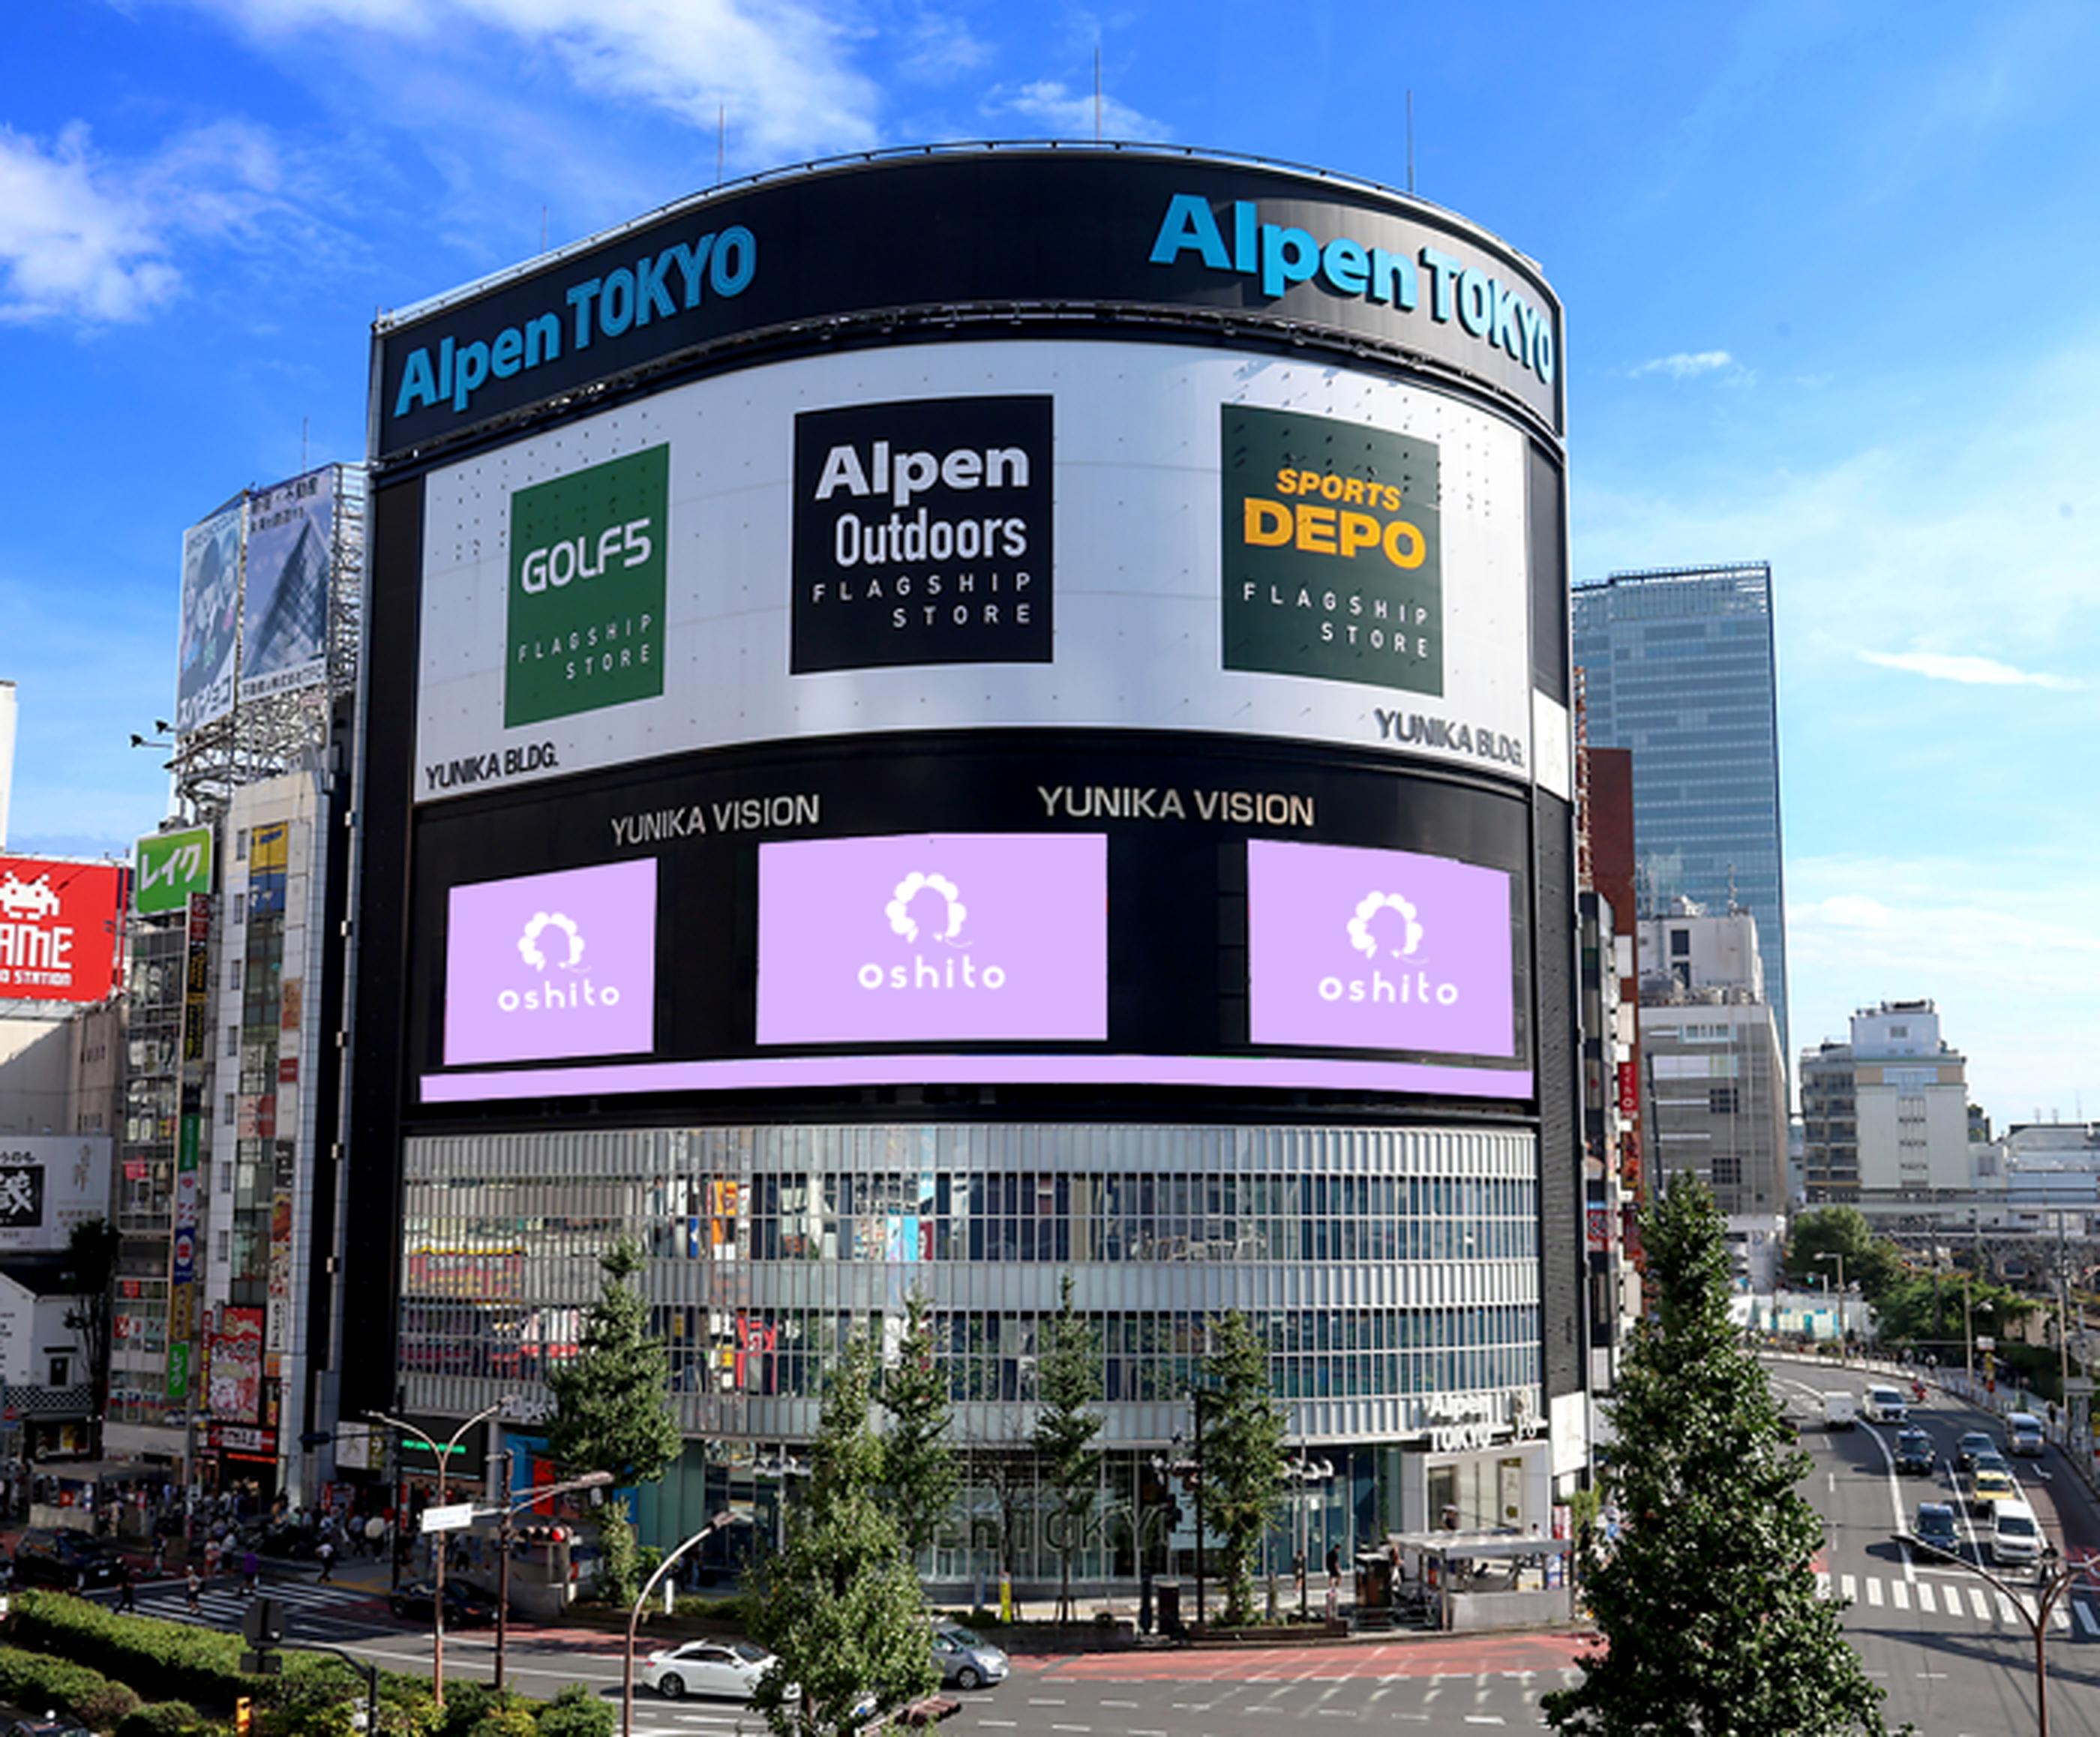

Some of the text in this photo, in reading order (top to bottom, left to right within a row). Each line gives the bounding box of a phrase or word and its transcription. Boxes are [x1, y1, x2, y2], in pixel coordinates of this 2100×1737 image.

[1149, 193, 1554, 386] Alpen TOKYO
[394, 224, 758, 418] Alpen TOKYO
[814, 440, 1030, 508] Alpen
[1276, 467, 1402, 512] SPORTS
[521, 517, 652, 595] GOLF5
[835, 506, 1028, 567] Outdoors
[1244, 496, 1427, 570] DEPO
[812, 571, 1031, 604] FLAGSHIP
[1243, 581, 1428, 626] FLAGSHIP
[518, 614, 652, 664] FLAGSHIP
[892, 603, 1030, 628] STORE
[1320, 621, 1428, 658] STORE
[566, 644, 650, 680] STORE
[1374, 707, 1525, 767] YUNIKA BLDG.
[425, 741, 559, 790] YUNIKA BLDG.
[610, 793, 821, 847] YUNIKA VISION
[1036, 785, 1315, 827] YUNIKA VISION
[140, 842, 202, 892] レイク
[497, 977, 620, 1012] oshito
[857, 954, 1006, 990] oshito
[1318, 970, 1459, 1006] oshito
